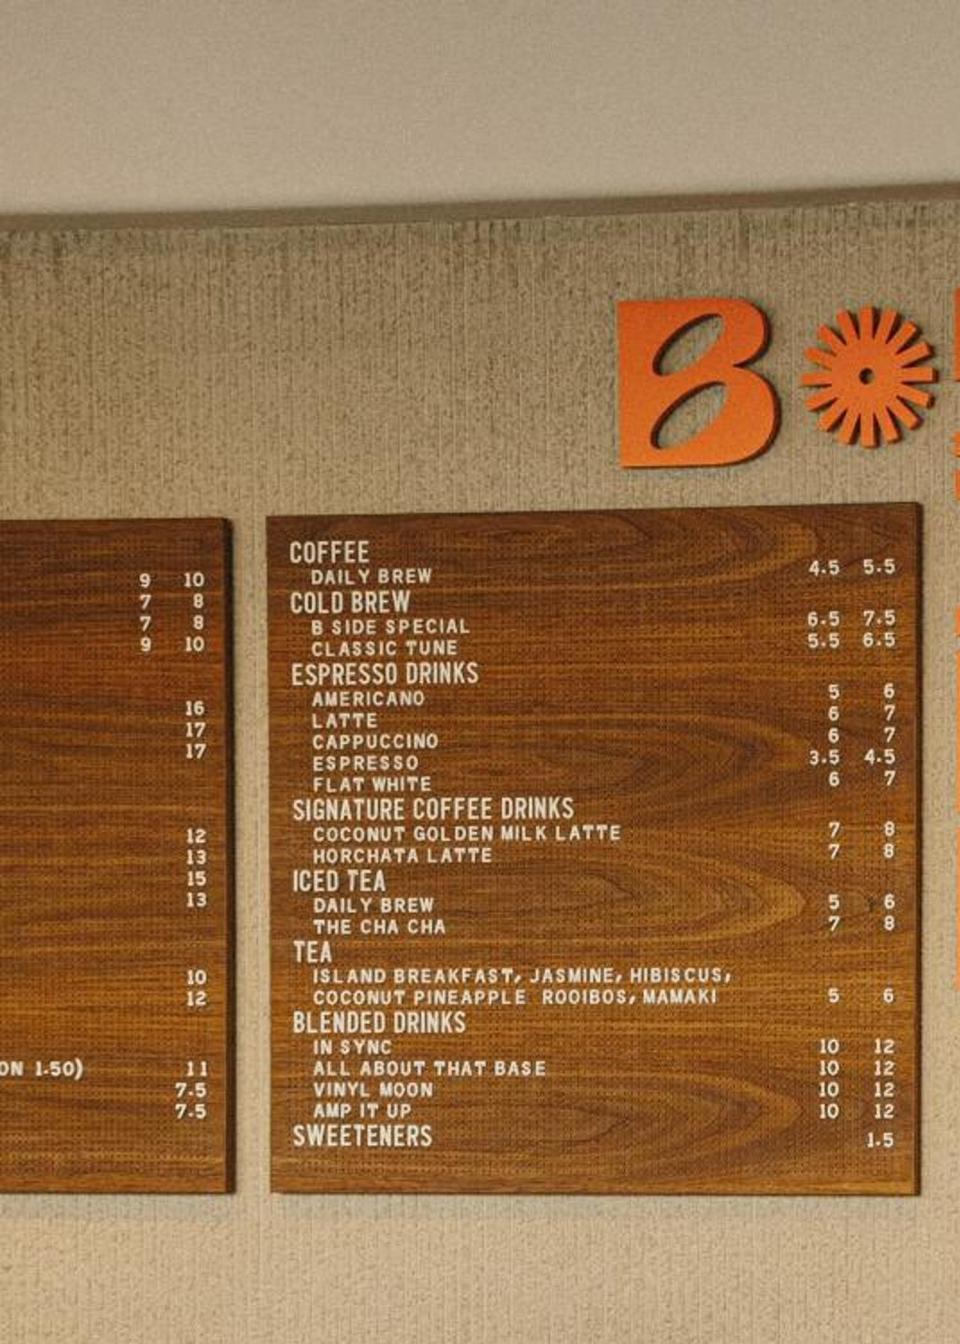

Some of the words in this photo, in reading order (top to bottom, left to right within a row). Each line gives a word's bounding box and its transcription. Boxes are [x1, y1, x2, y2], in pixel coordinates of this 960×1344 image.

[617, 296, 781, 469] B
[290, 540, 369, 564] COFFEE
[140, 573, 151, 588] 9
[185, 572, 204, 587] 10
[311, 569, 369, 585] DAILY
[378, 568, 432, 583] BREW
[809, 560, 840, 576] 4.5
[863, 558, 895, 574] 5.5
[139, 594, 151, 609] 7
[193, 593, 204, 608] 8
[291, 591, 343, 613] COLD
[352, 590, 410, 613] BREW
[140, 615, 151, 631] 7
[193, 615, 204, 630] 8
[312, 620, 323, 635] B
[332, 619, 376, 635] SIDE
[386, 618, 469, 634] SPECIAL
[808, 611, 839, 627] 6.5
[863, 609, 895, 626] 7.5
[141, 636, 151, 652] 9
[185, 636, 204, 652] 10
[312, 641, 396, 657] CLASSIC
[406, 640, 457, 655] TUNE
[808, 633, 839, 648] 5.5
[863, 631, 895, 647] 6.5
[292, 662, 397, 686] ESPRESSO
[406, 662, 478, 684] DRINKS
[312, 691, 424, 706] AMERICANO
[828, 684, 840, 700] 5
[883, 683, 895, 699] 6
[186, 701, 204, 716] 16
[312, 713, 377, 728] LATTE
[828, 706, 839, 721] 6
[884, 704, 895, 721] 7
[186, 722, 205, 737] 17
[313, 733, 438, 749] CAPPUCCINO
[828, 728, 839, 743] 6
[884, 727, 895, 742] 7
[186, 743, 206, 758] 17
[313, 755, 418, 771] ESPRESSO
[810, 749, 839, 765] 3.5
[864, 749, 895, 765] 4.5
[314, 777, 364, 792] FLAT
[372, 776, 431, 792] WHITE
[829, 771, 840, 787] 6
[884, 770, 896, 786] 7
[293, 798, 404, 821] SIGNATURE
[413, 797, 491, 820] COFFEE
[502, 797, 573, 819] DRINKS
[187, 829, 206, 844] 12
[313, 826, 405, 842] COCONUT
[414, 826, 493, 842] GOLDEN
[501, 826, 546, 841] MILK
[556, 825, 620, 841] LATTE
[829, 821, 840, 838] 7
[884, 821, 895, 837] 8
[187, 849, 206, 865] 13
[313, 848, 418, 864] HORCHATA
[427, 847, 491, 863] LATTE
[828, 843, 839, 859] 7
[883, 843, 894, 859] 8
[188, 871, 206, 886] 15
[293, 870, 338, 892] ICED
[348, 869, 385, 891] TEA
[187, 892, 206, 907] 13
[314, 898, 372, 913] DAILY
[381, 898, 433, 913] BREW
[829, 894, 839, 910] 5
[884, 893, 895, 909] 6
[313, 919, 351, 934] THE
[360, 919, 398, 934] CHA
[408, 919, 445, 934] CHA
[828, 916, 840, 931] 7
[884, 915, 895, 931] 8
[294, 940, 332, 963] TEA
[188, 970, 206, 985] 10
[314, 968, 386, 983] ISLAND
[394, 968, 521, 983] BREAKFAST,
[530, 968, 622, 983] JASMINE,
[630, 968, 730, 983] HIBISCUS,
[188, 990, 206, 1006] 12
[314, 990, 405, 1005] COCONUT
[414, 989, 525, 1005] PINEAPPLE
[543, 989, 635, 1004] ROOIBOS,
[643, 989, 716, 1004] MAMAKI
[828, 988, 839, 1003] 5
[883, 988, 894, 1004] 6
[294, 1011, 385, 1033] BLENDED
[394, 1011, 465, 1033] DRINKS
[314, 1039, 332, 1054] IN
[340, 1039, 391, 1054] SYNC
[820, 1038, 839, 1054] 10
[875, 1038, 895, 1054] 12
[187, 1061, 207, 1076] 11
[314, 1061, 350, 1076] ALL
[360, 1060, 425, 1076] ABOUT
[434, 1061, 486, 1076] THAT
[495, 1061, 545, 1076] BASE
[820, 1060, 839, 1076] 10
[875, 1060, 895, 1076] 12
[176, 1082, 206, 1098] 7.5
[314, 1082, 369, 1097] VINYL
[380, 1082, 432, 1097] MOON
[819, 1081, 839, 1097] 10
[875, 1082, 894, 1097] 12
[175, 1104, 206, 1119] 7.5
[314, 1103, 351, 1118] AMP
[360, 1103, 378, 1118] IT
[387, 1104, 411, 1118] UP
[820, 1103, 839, 1119] 10
[875, 1103, 894, 1119] 12
[294, 1124, 432, 1146] SWEETENERS
[868, 1132, 894, 1148] 1.5
